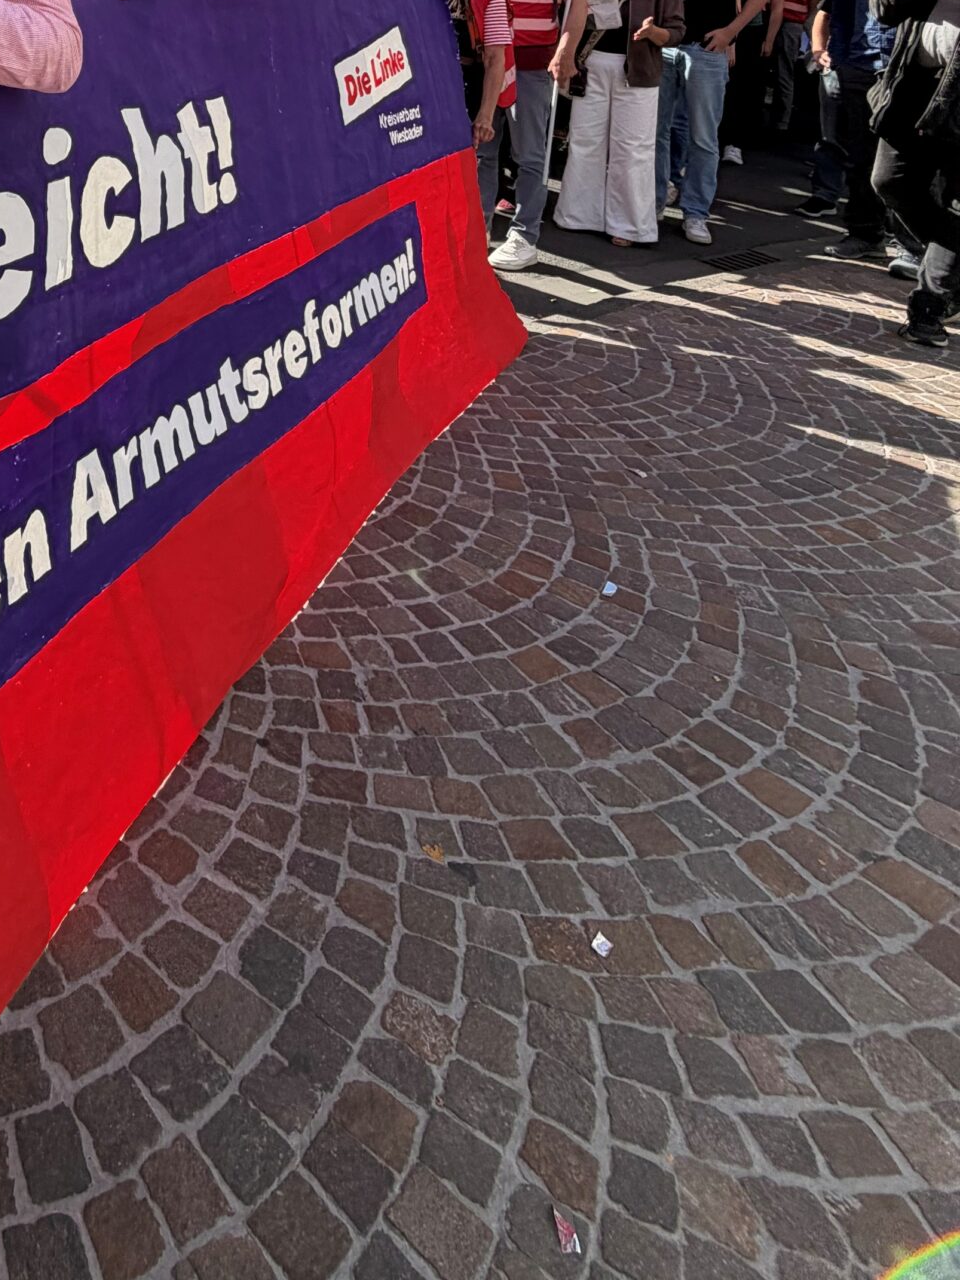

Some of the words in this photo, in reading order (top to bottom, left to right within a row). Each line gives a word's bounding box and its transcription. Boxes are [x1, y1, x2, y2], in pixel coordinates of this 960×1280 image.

[344, 66, 372, 106] Die
[370, 47, 405, 88] Linke
[379, 104, 422, 129] Kreisverband
[389, 123, 423, 146] Wiesbaden
[69, 238, 417, 552] Armutsreformen!
